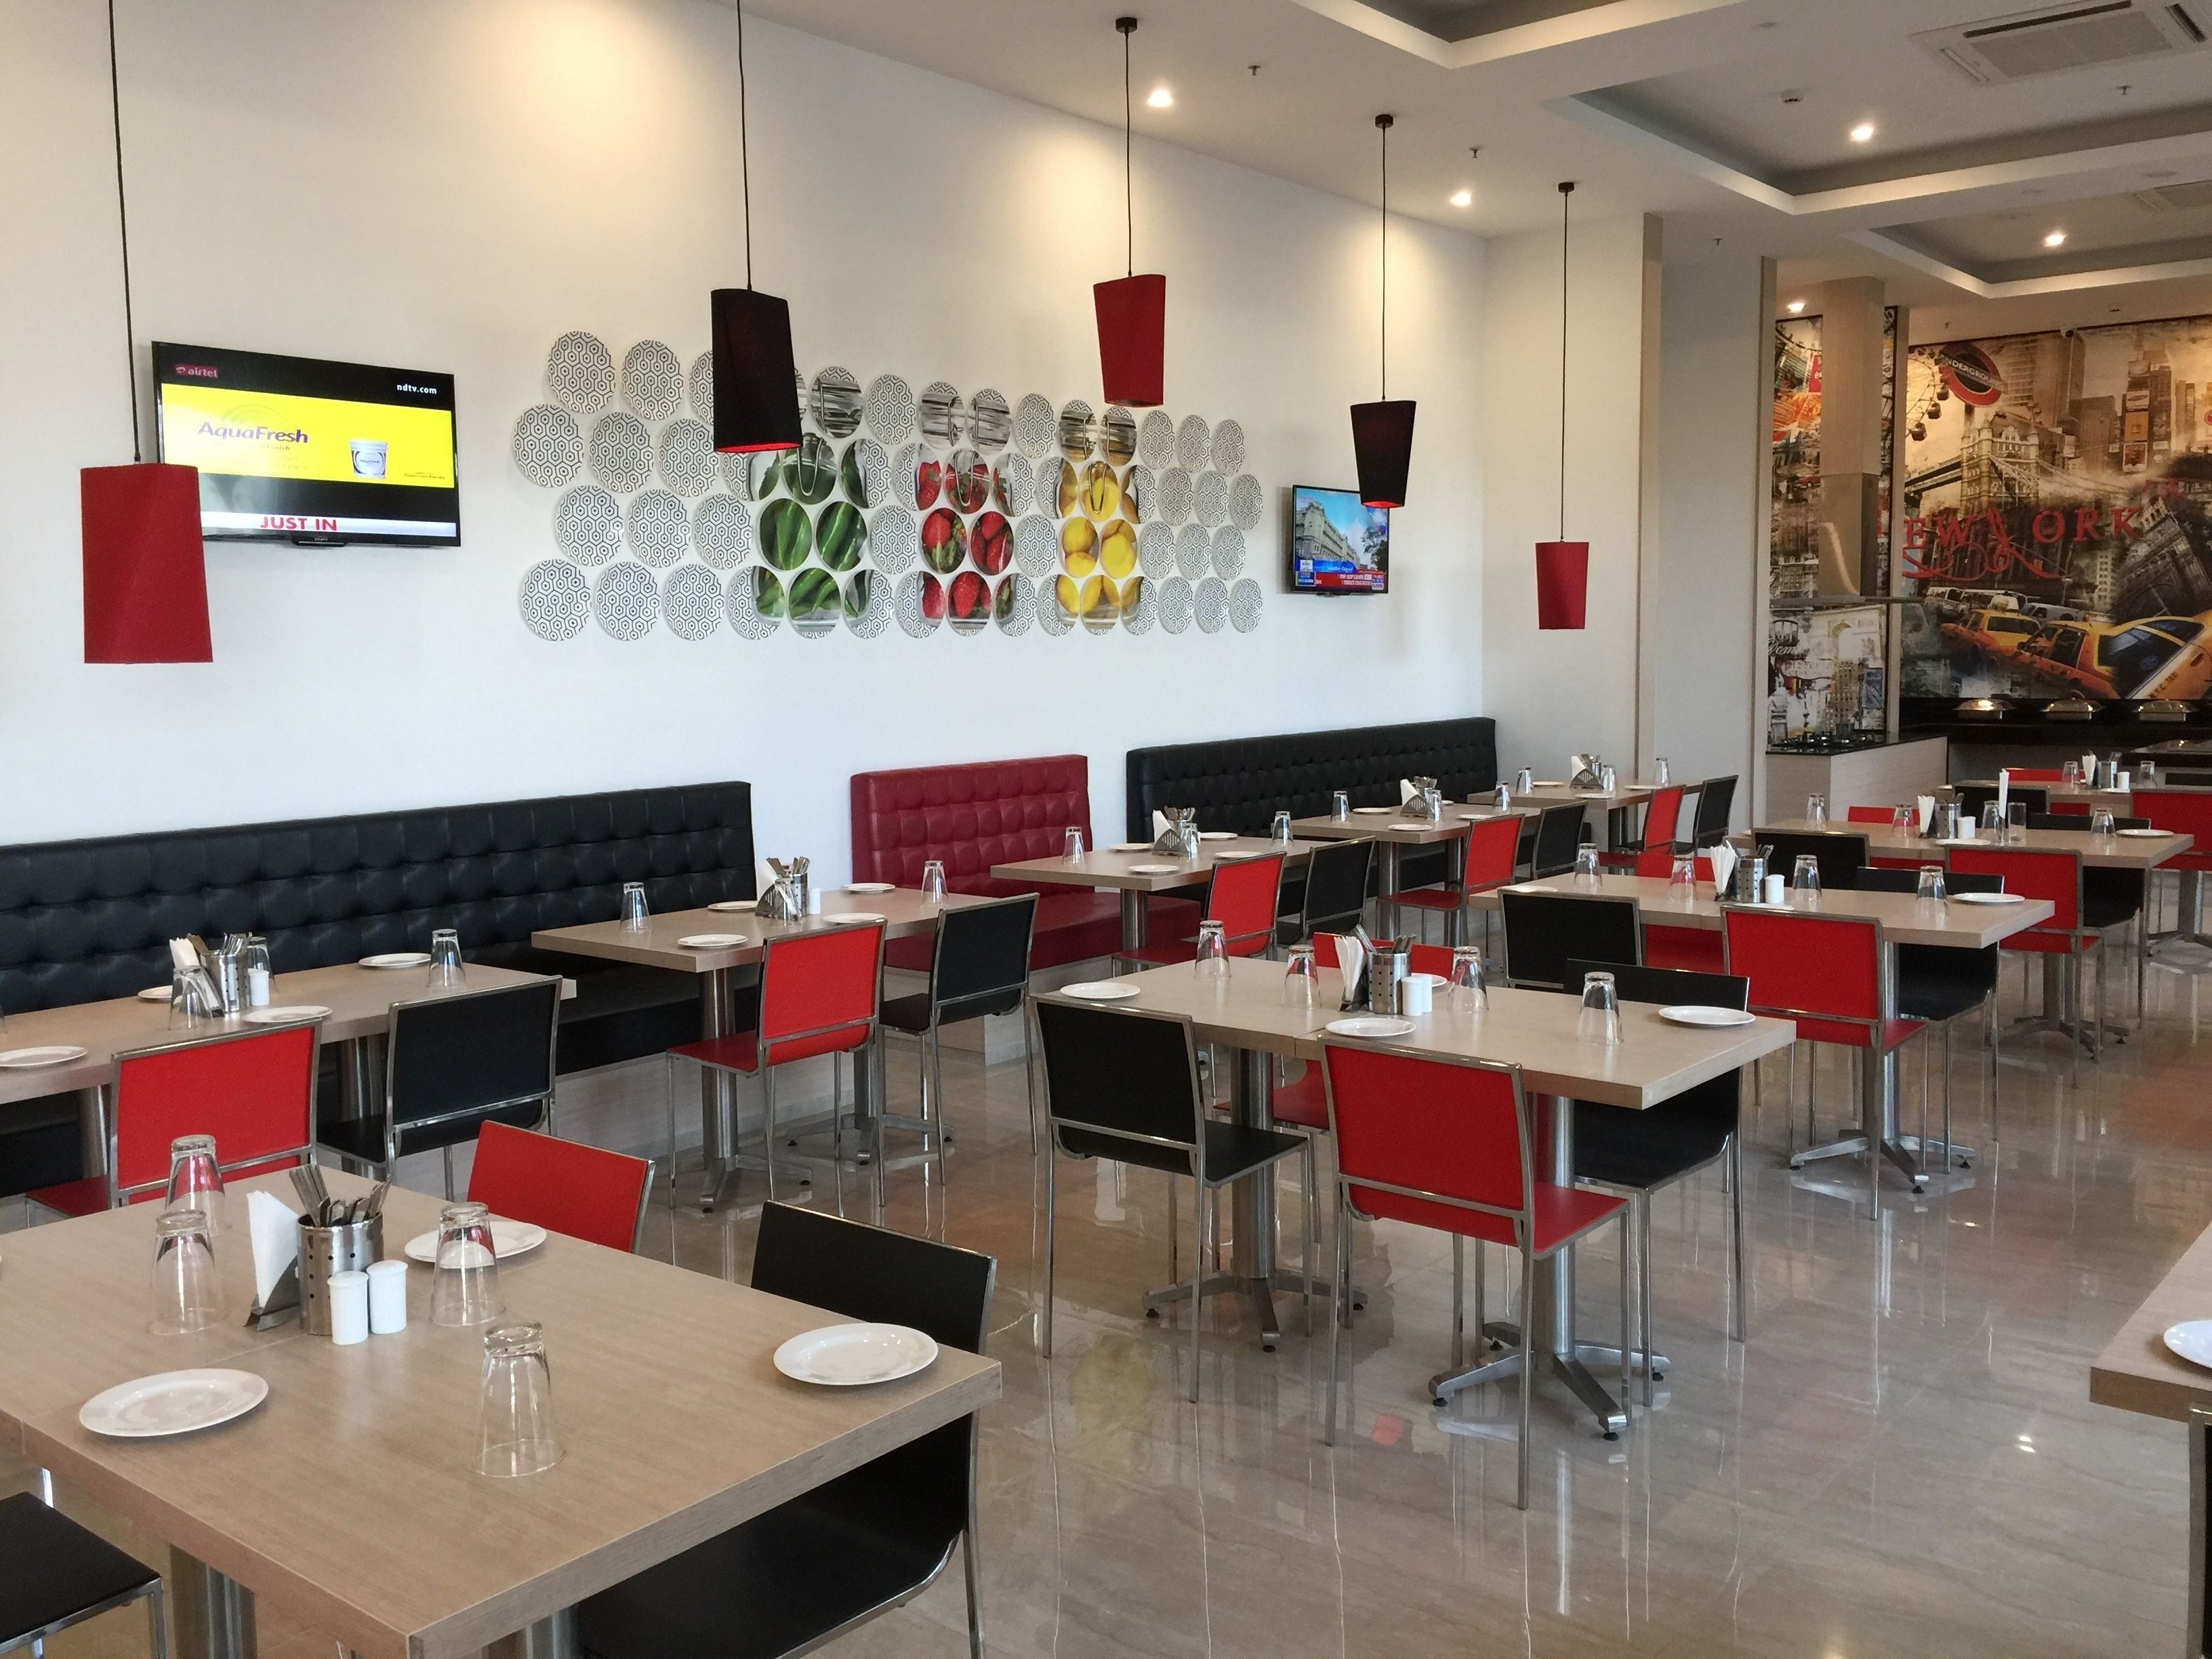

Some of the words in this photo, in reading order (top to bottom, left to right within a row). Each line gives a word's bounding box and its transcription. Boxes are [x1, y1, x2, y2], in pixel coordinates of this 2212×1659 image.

[188, 367, 218, 377] airtel
[1941, 355, 2002, 389] NDERGROU
[396, 383, 437, 394] ndtv.com
[198, 422, 308, 443] AquaFresh
[260, 516, 308, 530] JUST
[315, 518, 337, 531] IN
[1903, 513, 1976, 550] EW
